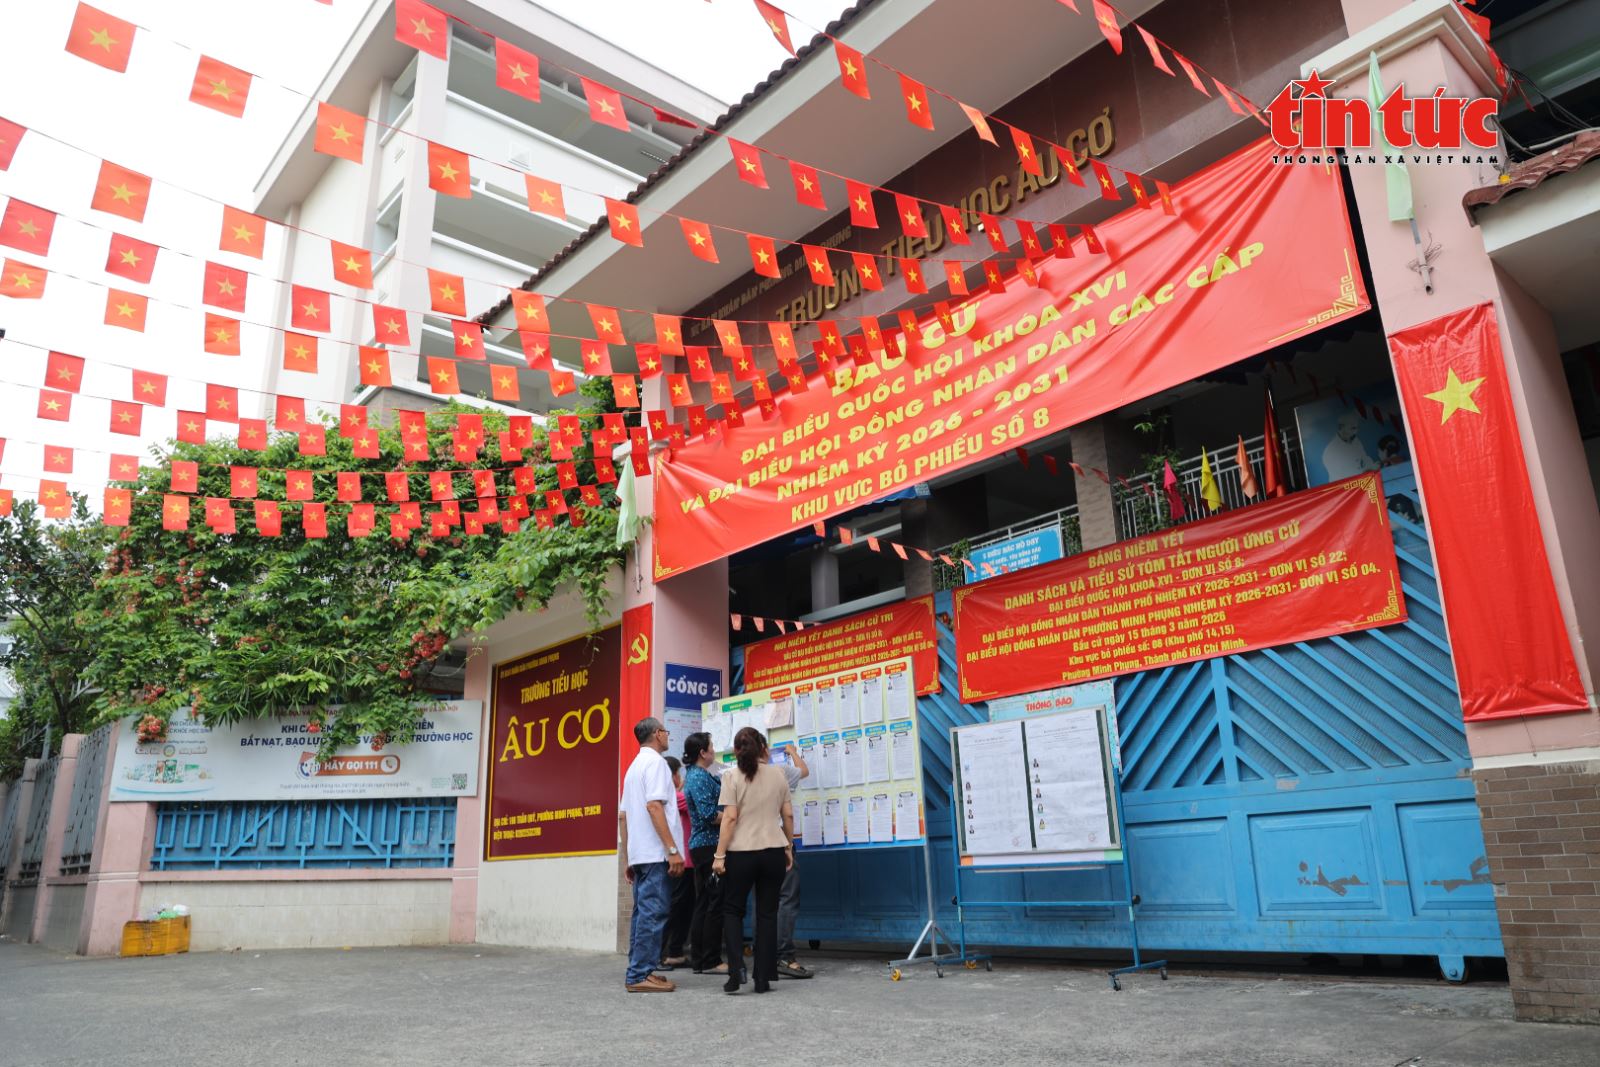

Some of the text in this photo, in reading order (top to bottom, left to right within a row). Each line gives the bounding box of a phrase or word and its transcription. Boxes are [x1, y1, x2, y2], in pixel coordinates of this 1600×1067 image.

[776, 265, 867, 330] TRƯỜN
[1065, 105, 1116, 168] CƠ
[680, 241, 1265, 514] VÀ ĐẠI BIỂU HỘI ĐỒNG NHÂN DÂN CÁC CẤP
[741, 271, 1128, 465] ĐẠI BIỂU QUỐC HỘI KHÓA XVI
[777, 459, 849, 502] NHIỆM
[857, 440, 888, 468] KỲ
[896, 410, 963, 450] 2026
[994, 364, 1070, 412] 2031
[791, 407, 1050, 523] KHU VỰC BỎ PHIẾU SỐ 8
[1005, 592, 1035, 610] DANH
[1037, 584, 1067, 602] SÁCH
[1070, 577, 1086, 593] VÀ
[1088, 568, 1115, 589] TIỂU
[1117, 562, 1135, 580] SỬ
[1138, 557, 1166, 576] TÓM
[1195, 536, 1240, 562] NGƯỜI
[1243, 526, 1275, 549] ỨNG
[1278, 519, 1301, 540] CỬ
[1088, 549, 1122, 569] BẢNG
[1162, 529, 1185, 548] YẾT
[980, 643, 998, 659] BIỂU
[999, 643, 1013, 657] HỘI
[1037, 632, 1061, 647] NHÂN
[1062, 628, 1081, 642] DÂN
[1083, 620, 1119, 637] PHƯỜNG
[1121, 614, 1147, 629] MINH
[1148, 606, 1181, 624] PHỤNG
[1183, 598, 1217, 615] NHIỆM
[1219, 594, 1233, 608] KỲ
[1299, 574, 1324, 590] ĐƠN
[1326, 570, 1339, 584] VỊ
[1341, 562, 1358, 580] SỐ
[1360, 562, 1382, 577] 04.
[982, 633, 996, 645] ĐẠI
[1016, 623, 1029, 637] HỘI
[1055, 613, 1080, 628] NHÂN
[1081, 608, 1100, 622] DÂN
[1102, 599, 1132, 617] THÀNH
[1134, 593, 1153, 610] PHỐ
[1155, 588, 1187, 604] NHIỆM
[1189, 582, 1202, 597] KỲ
[1205, 570, 1259, 593] 2026-2031
[1269, 563, 1293, 578] ĐƠN
[1295, 559, 1307, 573] VỊ
[1310, 551, 1326, 568] SỐ
[1328, 551, 1348, 565] 22;
[1049, 601, 1064, 613] ĐẠI
[1065, 596, 1084, 609] BIỂU
[1087, 588, 1110, 604] QUỐC
[1112, 585, 1128, 598] HỘI
[1157, 574, 1173, 587] XVI
[1181, 566, 1203, 581] ĐƠN
[1205, 564, 1216, 577] VỊ
[1218, 558, 1232, 572] SỐ
[1234, 556, 1245, 568] 8;
[1062, 668, 1092, 681] Phường
[1092, 663, 1113, 675] Minh
[1144, 652, 1170, 666] Thành
[1171, 647, 1188, 662] phố
[1189, 644, 1202, 657] Hồ
[1204, 642, 1219, 654] Chí
[1220, 638, 1248, 651] Minh.
[1068, 655, 1084, 666] Khu
[1101, 647, 1112, 659] bỏ
[1113, 643, 1136, 658] phiếu
[1138, 640, 1151, 652] số:
[1165, 635, 1185, 648] (Khu
[1187, 629, 1204, 646] phố
[1206, 624, 1236, 640] 14,15)
[1072, 639, 1089, 652] Bầu
[1104, 633, 1125, 647] ngày
[1128, 629, 1139, 641] 15
[1141, 622, 1167, 637] tháng
[1169, 620, 1176, 632] 3
[1178, 617, 1199, 631] năm
[1201, 611, 1226, 626] 2026
[520, 669, 589, 705] TRƯỜNG TIỂU HỌC
[666, 675, 720, 698] CỔNG 2
[261, 737, 284, 749] NẠT,
[285, 737, 306, 748] BẠO
[412, 731, 451, 743] TRƯỜNG
[452, 732, 474, 744] HỌC
[281, 725, 298, 733] KHI
[499, 698, 611, 763] ÂU CƠ
[324, 760, 378, 773] HÃY GỌI 111
